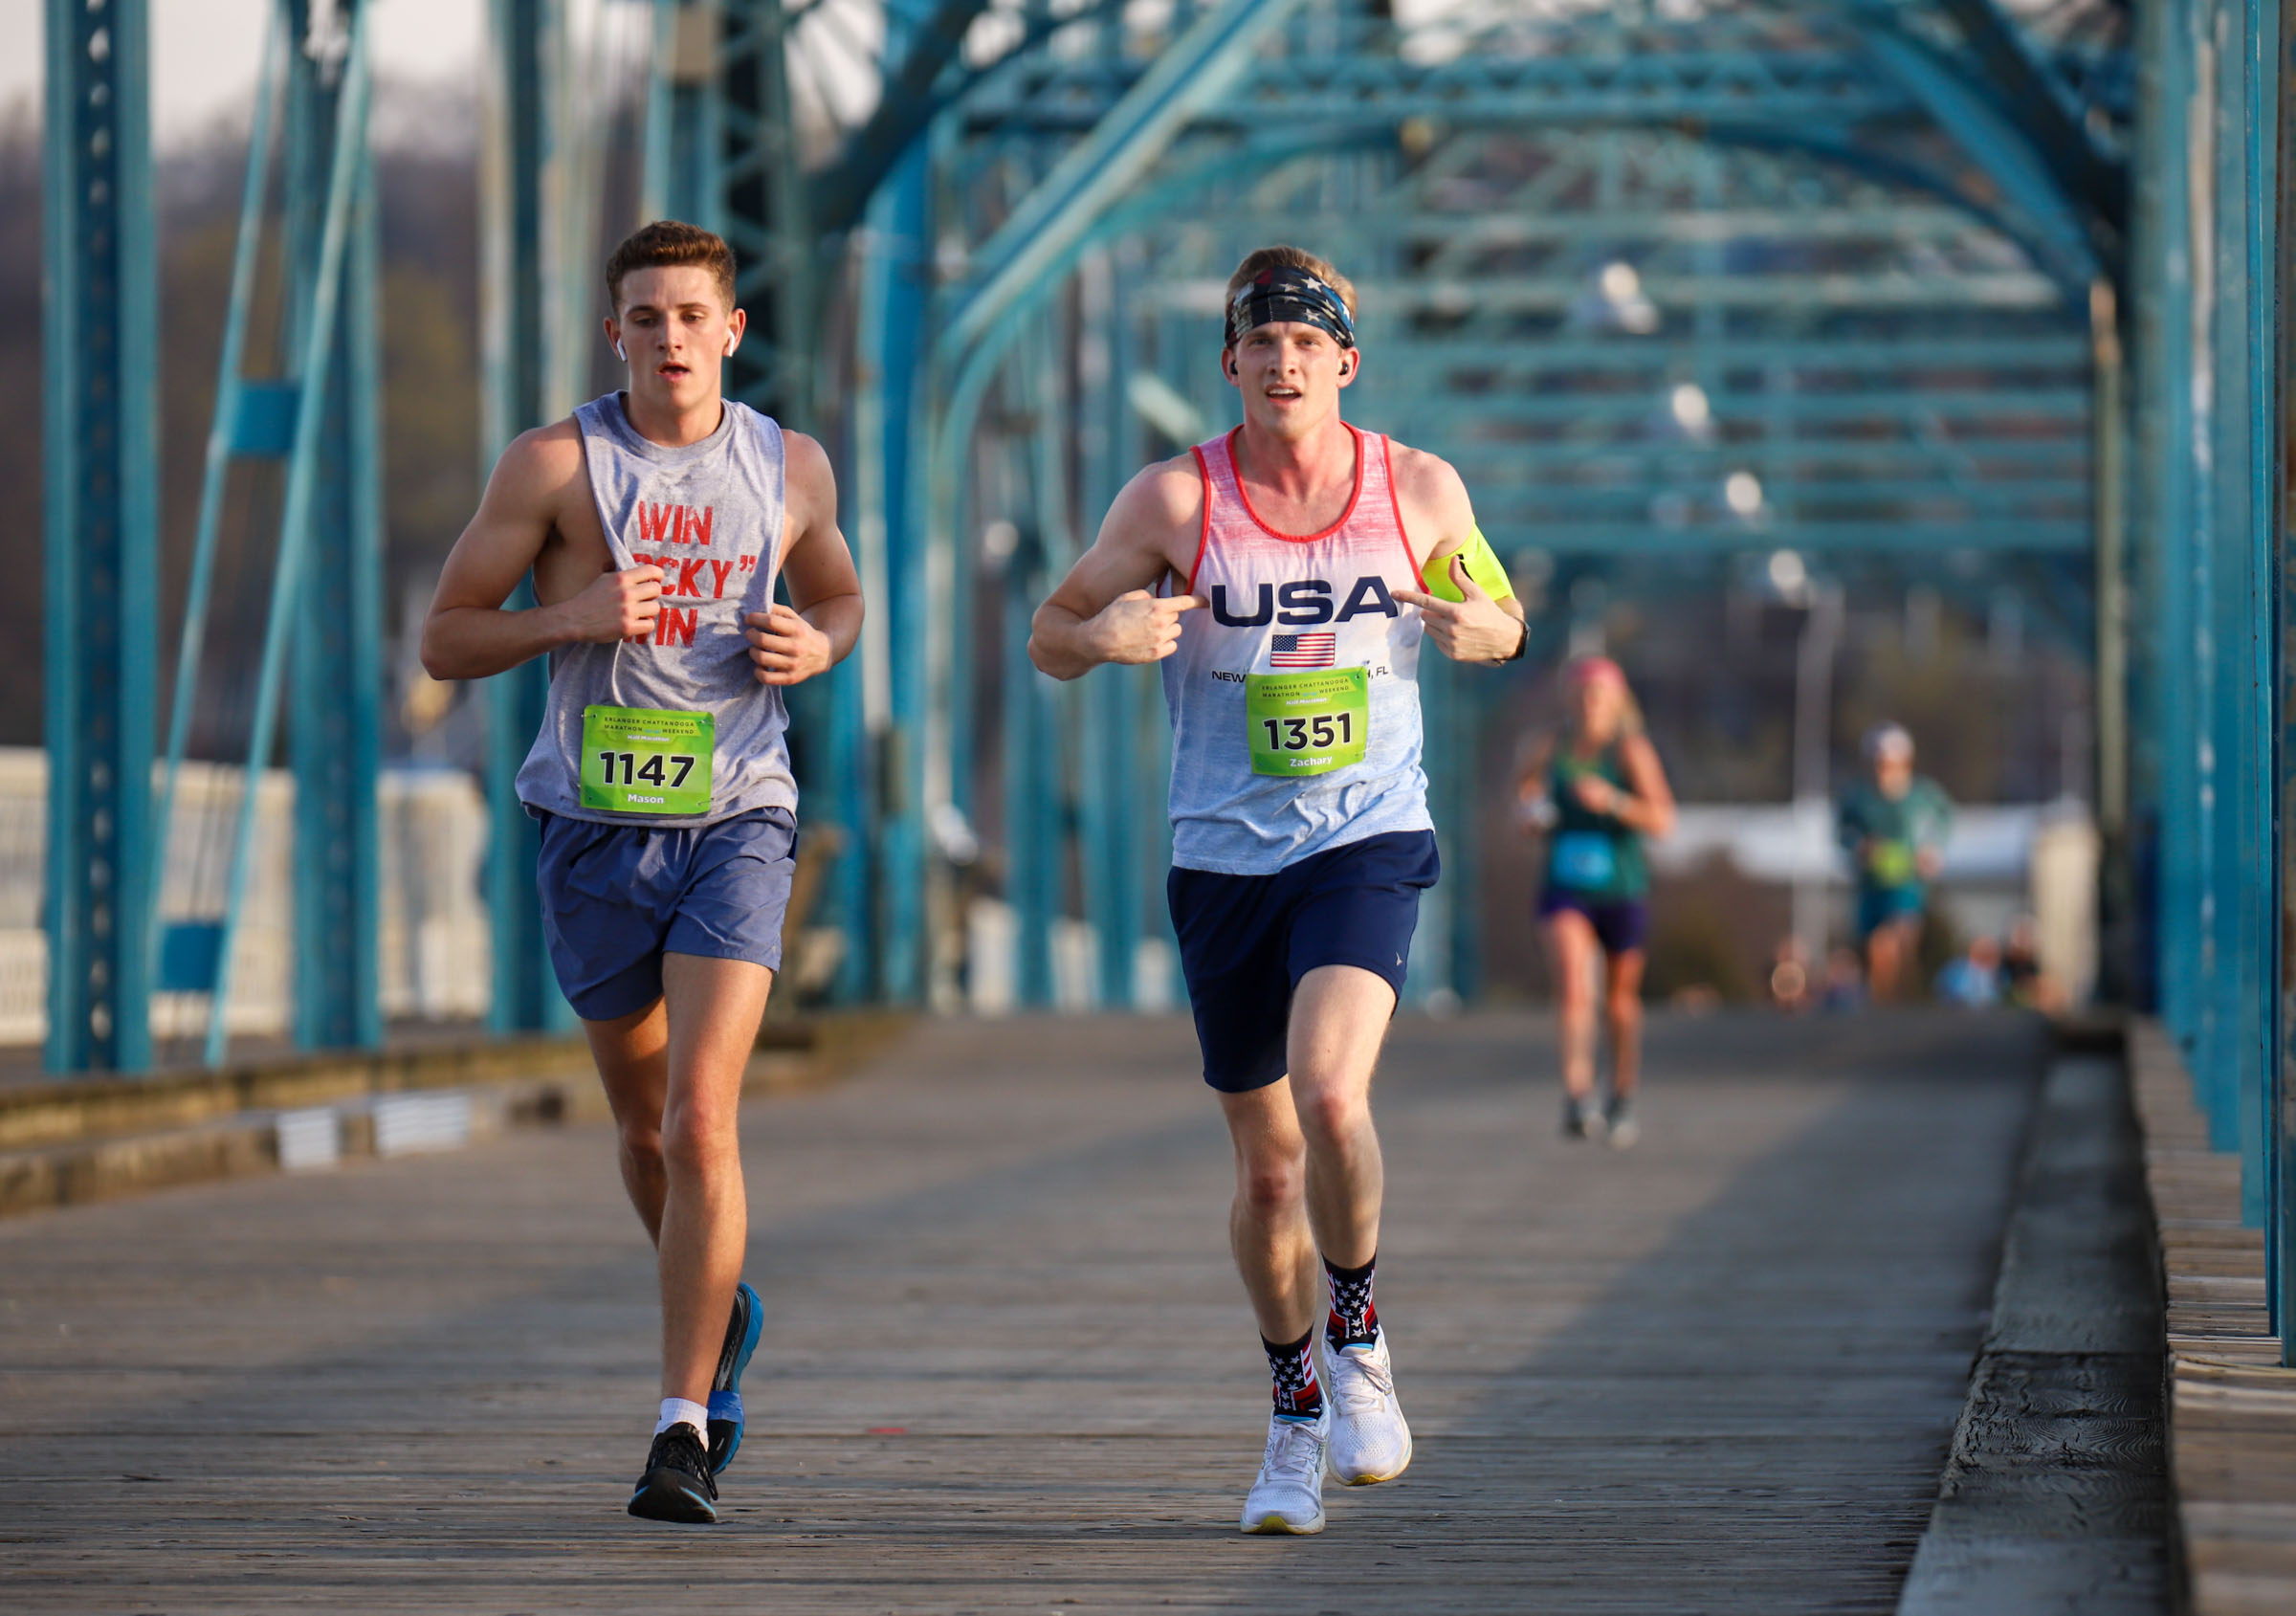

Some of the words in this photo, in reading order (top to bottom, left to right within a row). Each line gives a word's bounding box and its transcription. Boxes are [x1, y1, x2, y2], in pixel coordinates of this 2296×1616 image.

[638, 500, 714, 546] WIN
[1211, 576, 1398, 627] USA
[623, 608, 698, 648] IN
[1211, 671, 1247, 682] NEW
[1377, 666, 1388, 676] FL
[1299, 677, 1349, 689] CHATTANOOGA
[1319, 685, 1350, 694] WEEKEND
[642, 719, 695, 727] CHATTANOOGA
[1263, 712, 1351, 751] 1351
[1290, 756, 1333, 768] Zachary
[600, 751, 695, 787] 1147
[628, 793, 665, 805] Mason
